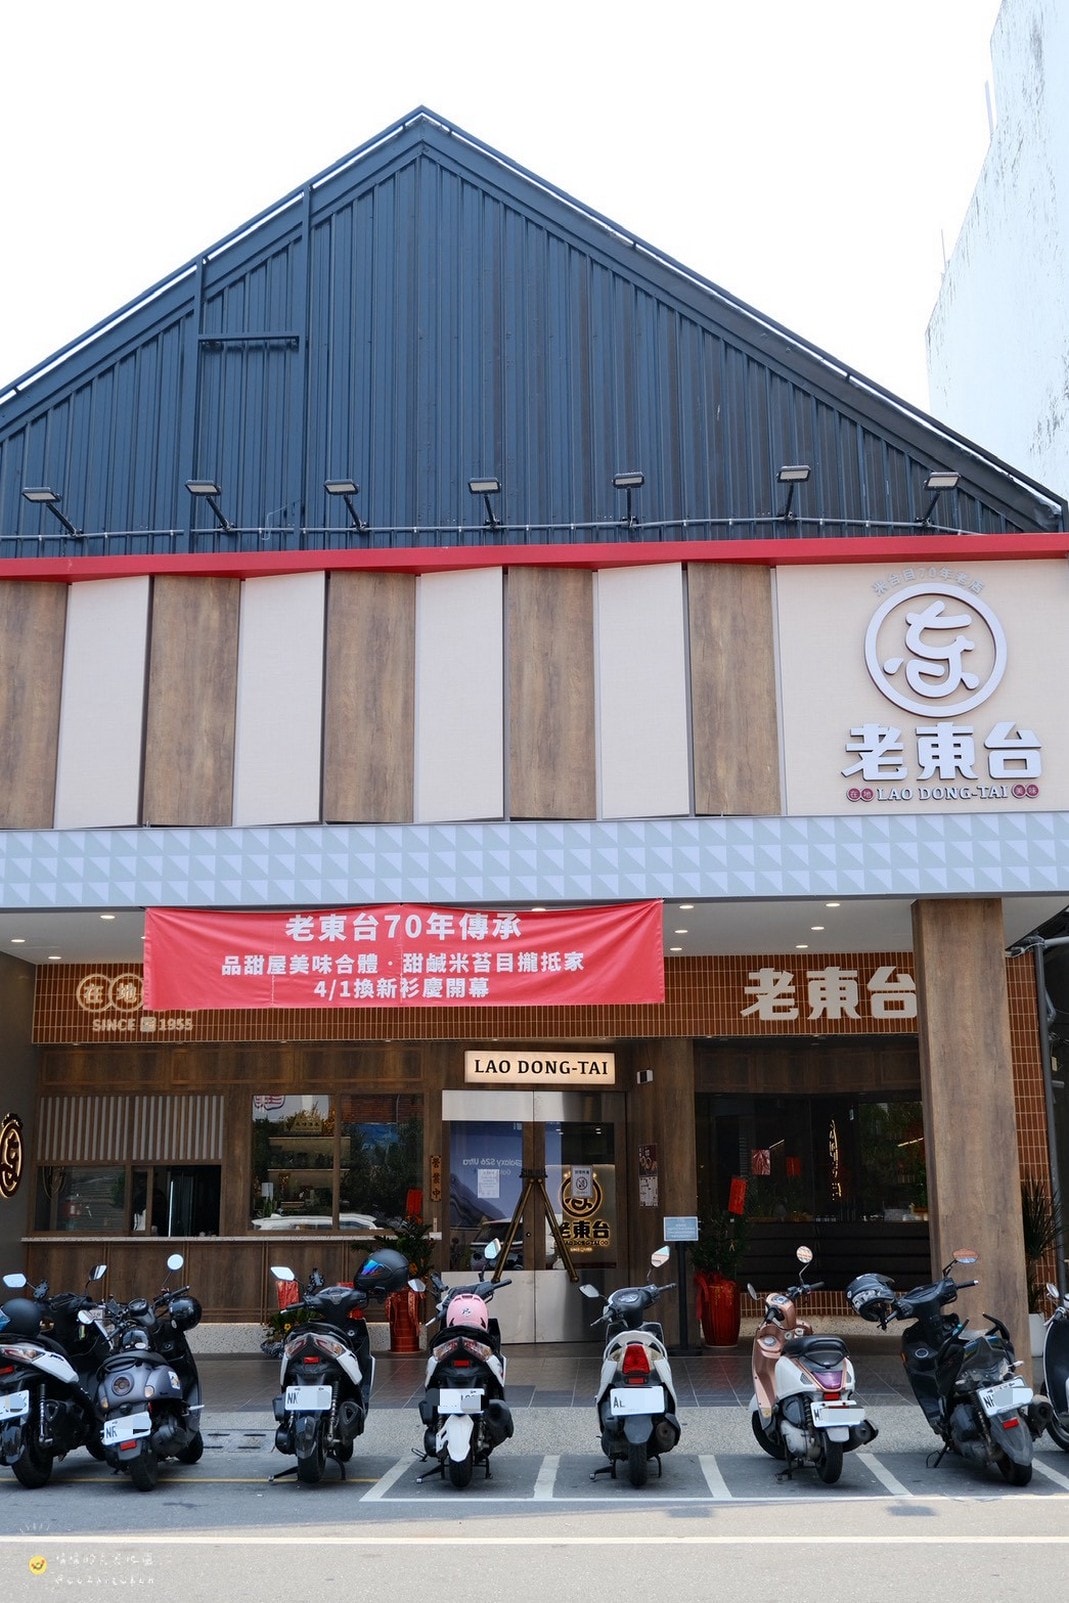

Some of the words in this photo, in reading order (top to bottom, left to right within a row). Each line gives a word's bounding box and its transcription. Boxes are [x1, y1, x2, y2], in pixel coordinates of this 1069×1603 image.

[841, 721, 1042, 781] 老東台
[877, 787, 913, 801] LAO
[919, 785, 1008, 801] DONG-TAI
[284, 912, 522, 942] 老東台70年傳承
[82, 982, 138, 1004] 在地
[313, 977, 489, 1002] 4/1換新衫慶開幕
[740, 966, 917, 1020] 老東台
[92, 1018, 136, 1032] SINCE
[159, 1018, 193, 1032] 1955
[474, 1059, 511, 1074] LAO
[517, 1060, 608, 1075] DONG-TAI
